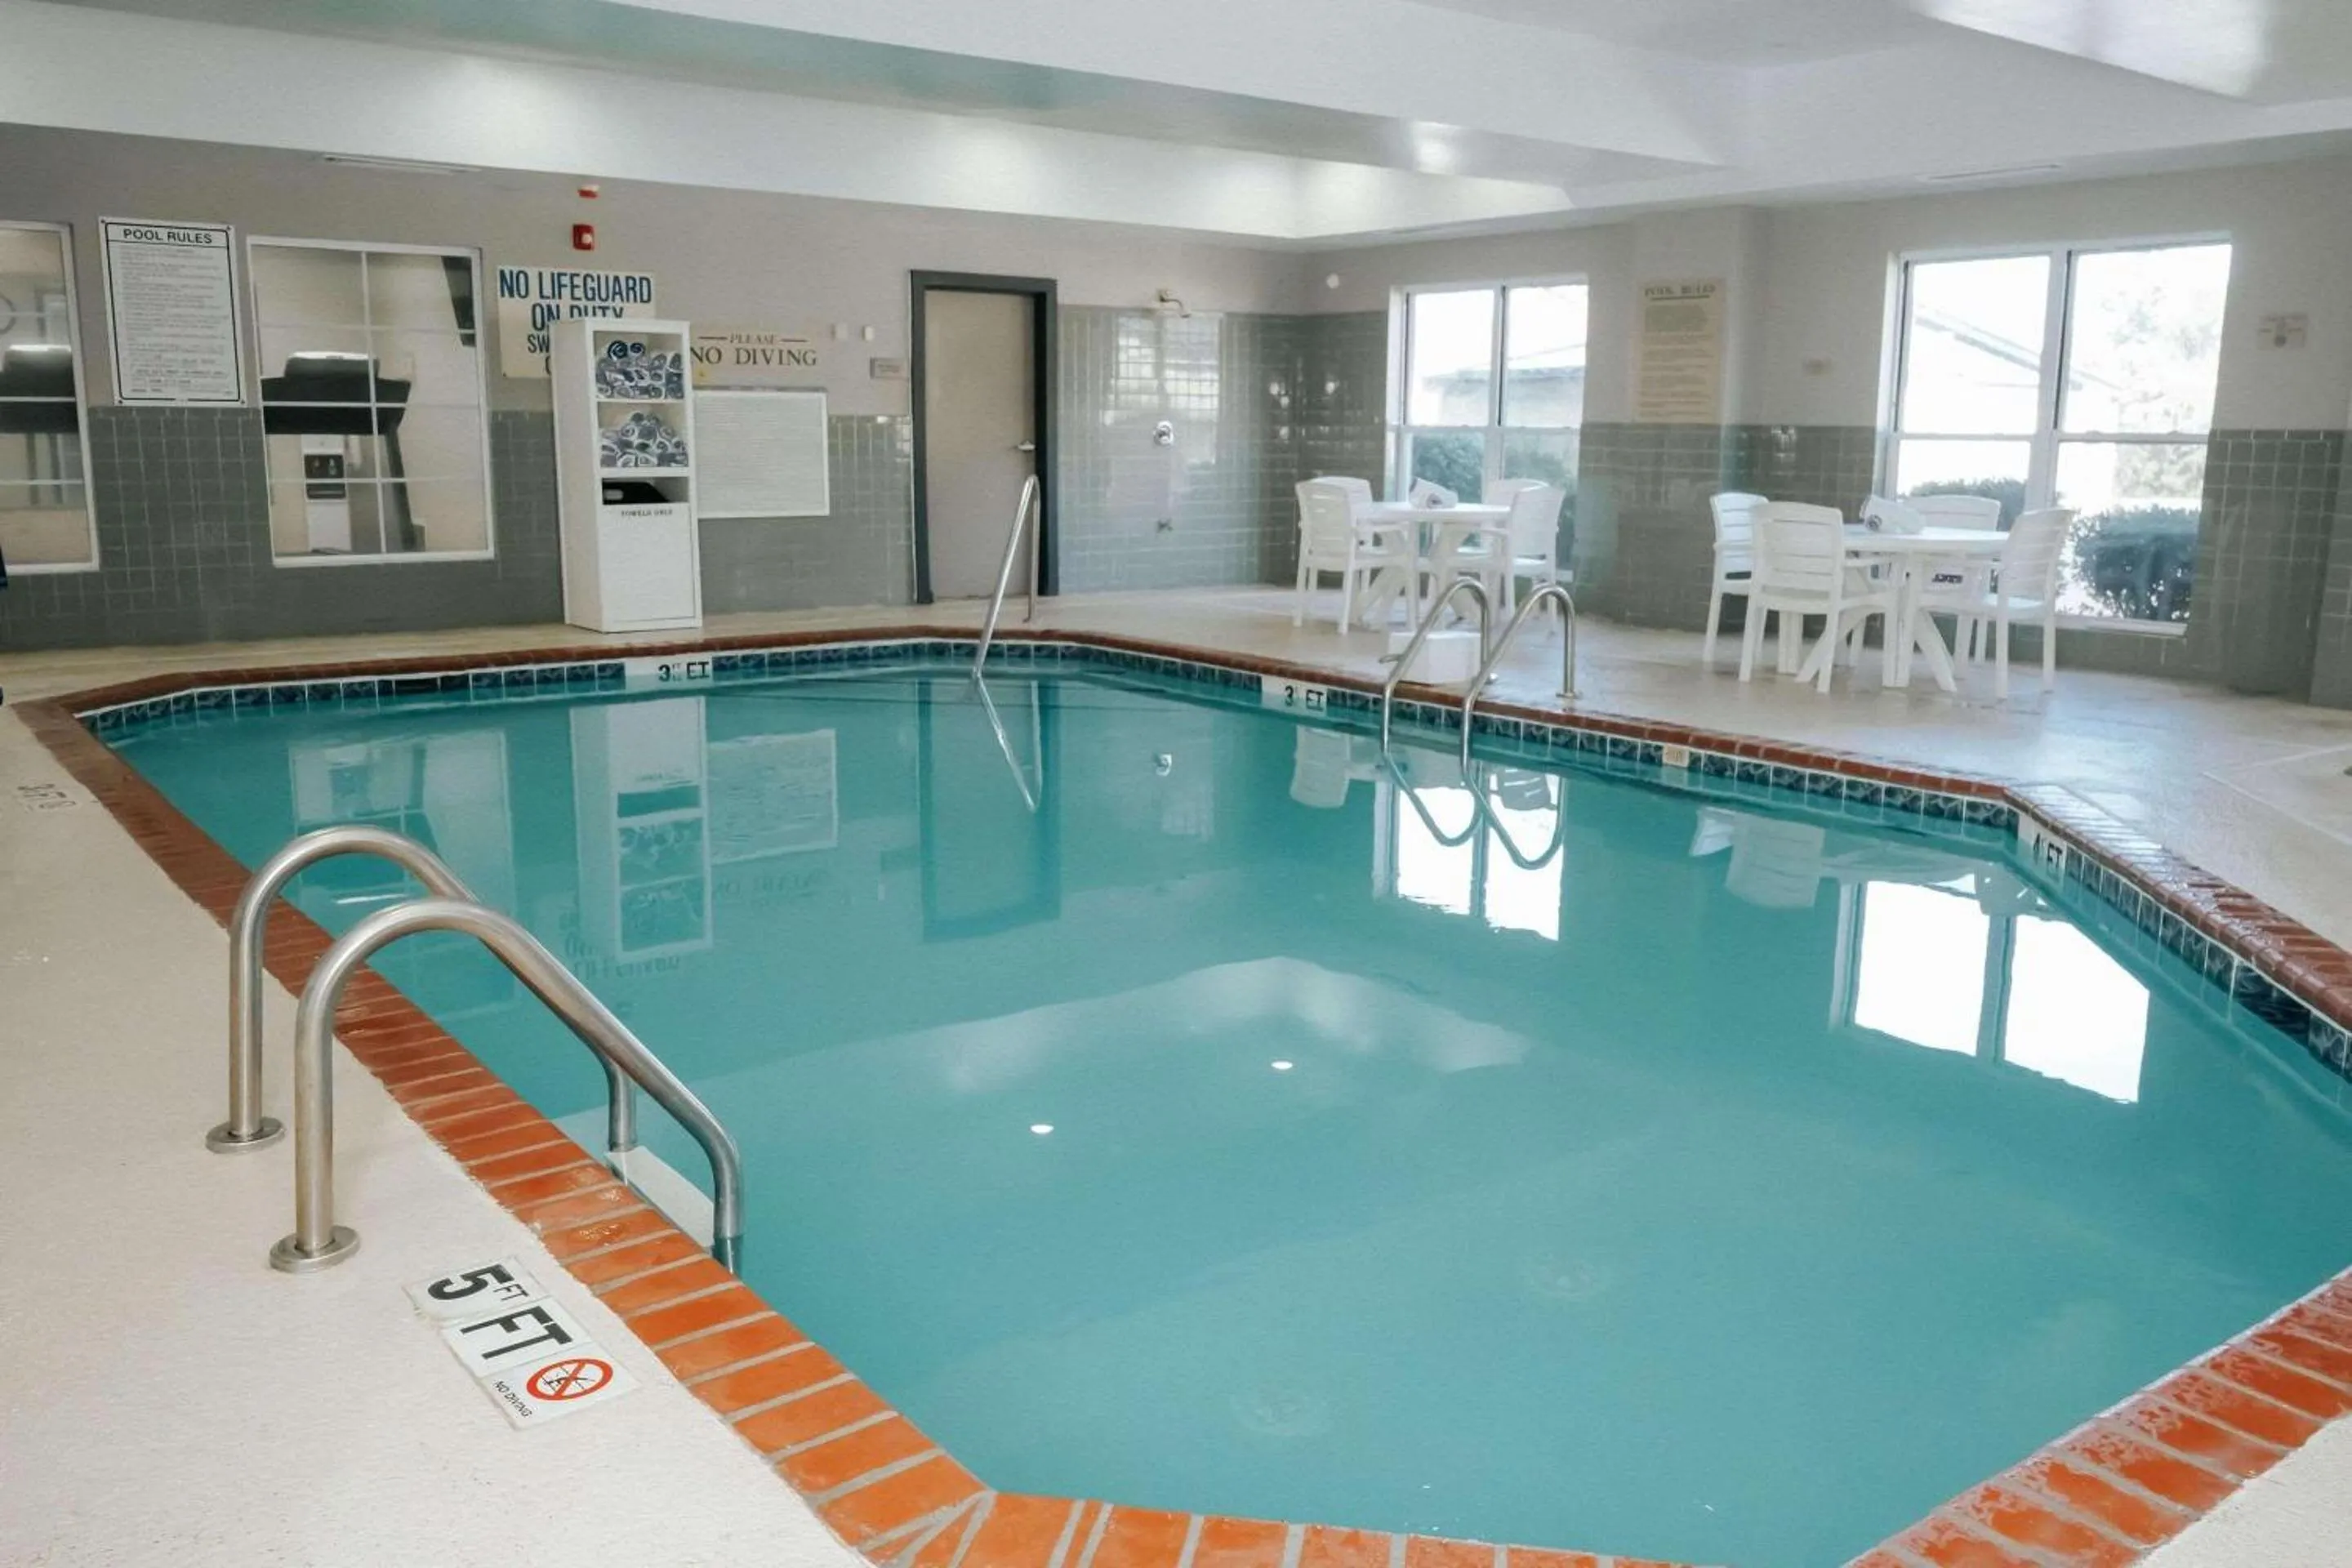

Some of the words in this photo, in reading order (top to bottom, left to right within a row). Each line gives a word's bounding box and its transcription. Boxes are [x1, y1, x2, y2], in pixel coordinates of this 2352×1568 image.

[123, 229, 163, 241] POOL
[167, 231, 212, 244] RULES
[500, 269, 529, 299] NO
[538, 271, 652, 304] LIFEGUARD
[532, 303, 560, 331] ON
[690, 346, 723, 365] NO
[735, 347, 817, 366] DIVING
[427, 1264, 514, 1300] 5
[459, 1305, 573, 1360] FT
[492, 1380, 510, 1393] NO
[504, 1392, 532, 1417] DIVING
